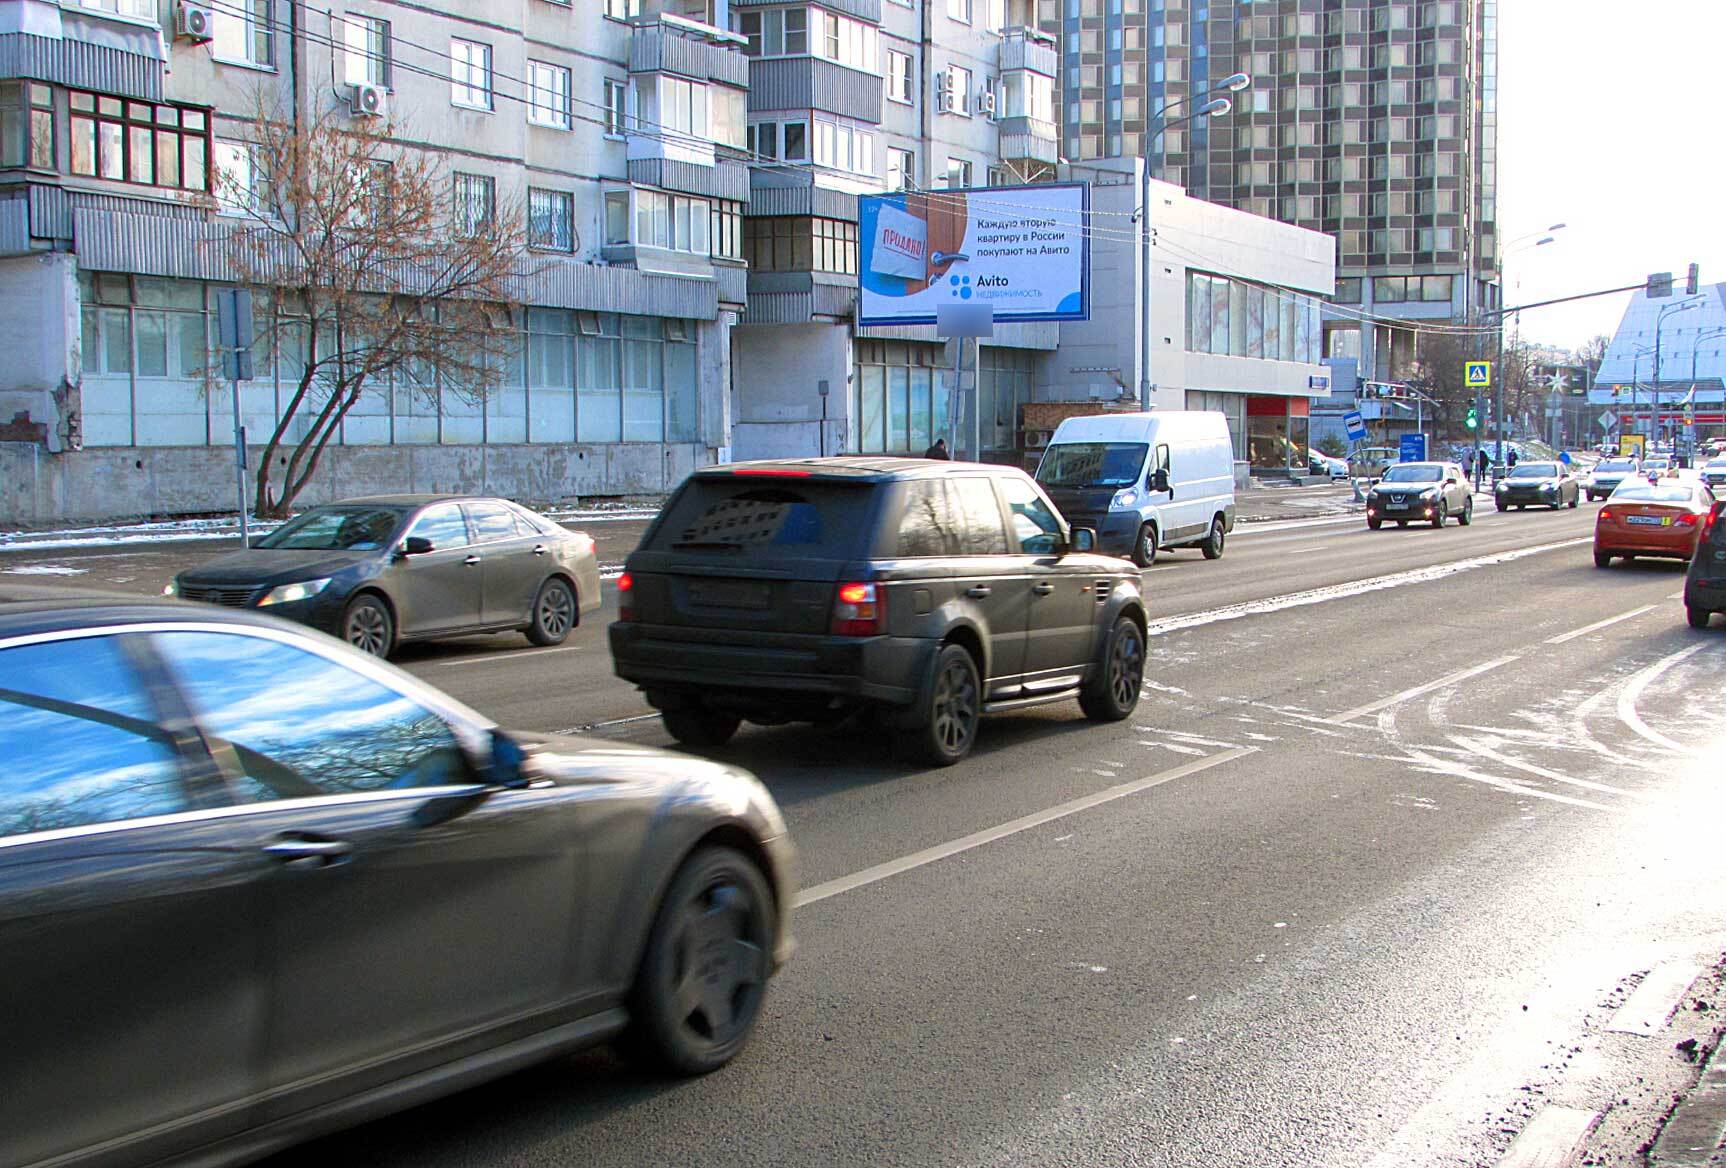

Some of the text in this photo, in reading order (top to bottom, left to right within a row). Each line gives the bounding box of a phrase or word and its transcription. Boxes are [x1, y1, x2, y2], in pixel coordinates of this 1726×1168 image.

[977, 218, 1057, 230] Каждую вторую
[977, 234, 1020, 245] квартиру
[1031, 231, 1065, 241] России
[977, 248, 1023, 258] покупают
[1039, 245, 1070, 255] Авито
[976, 274, 1009, 287] Avito
